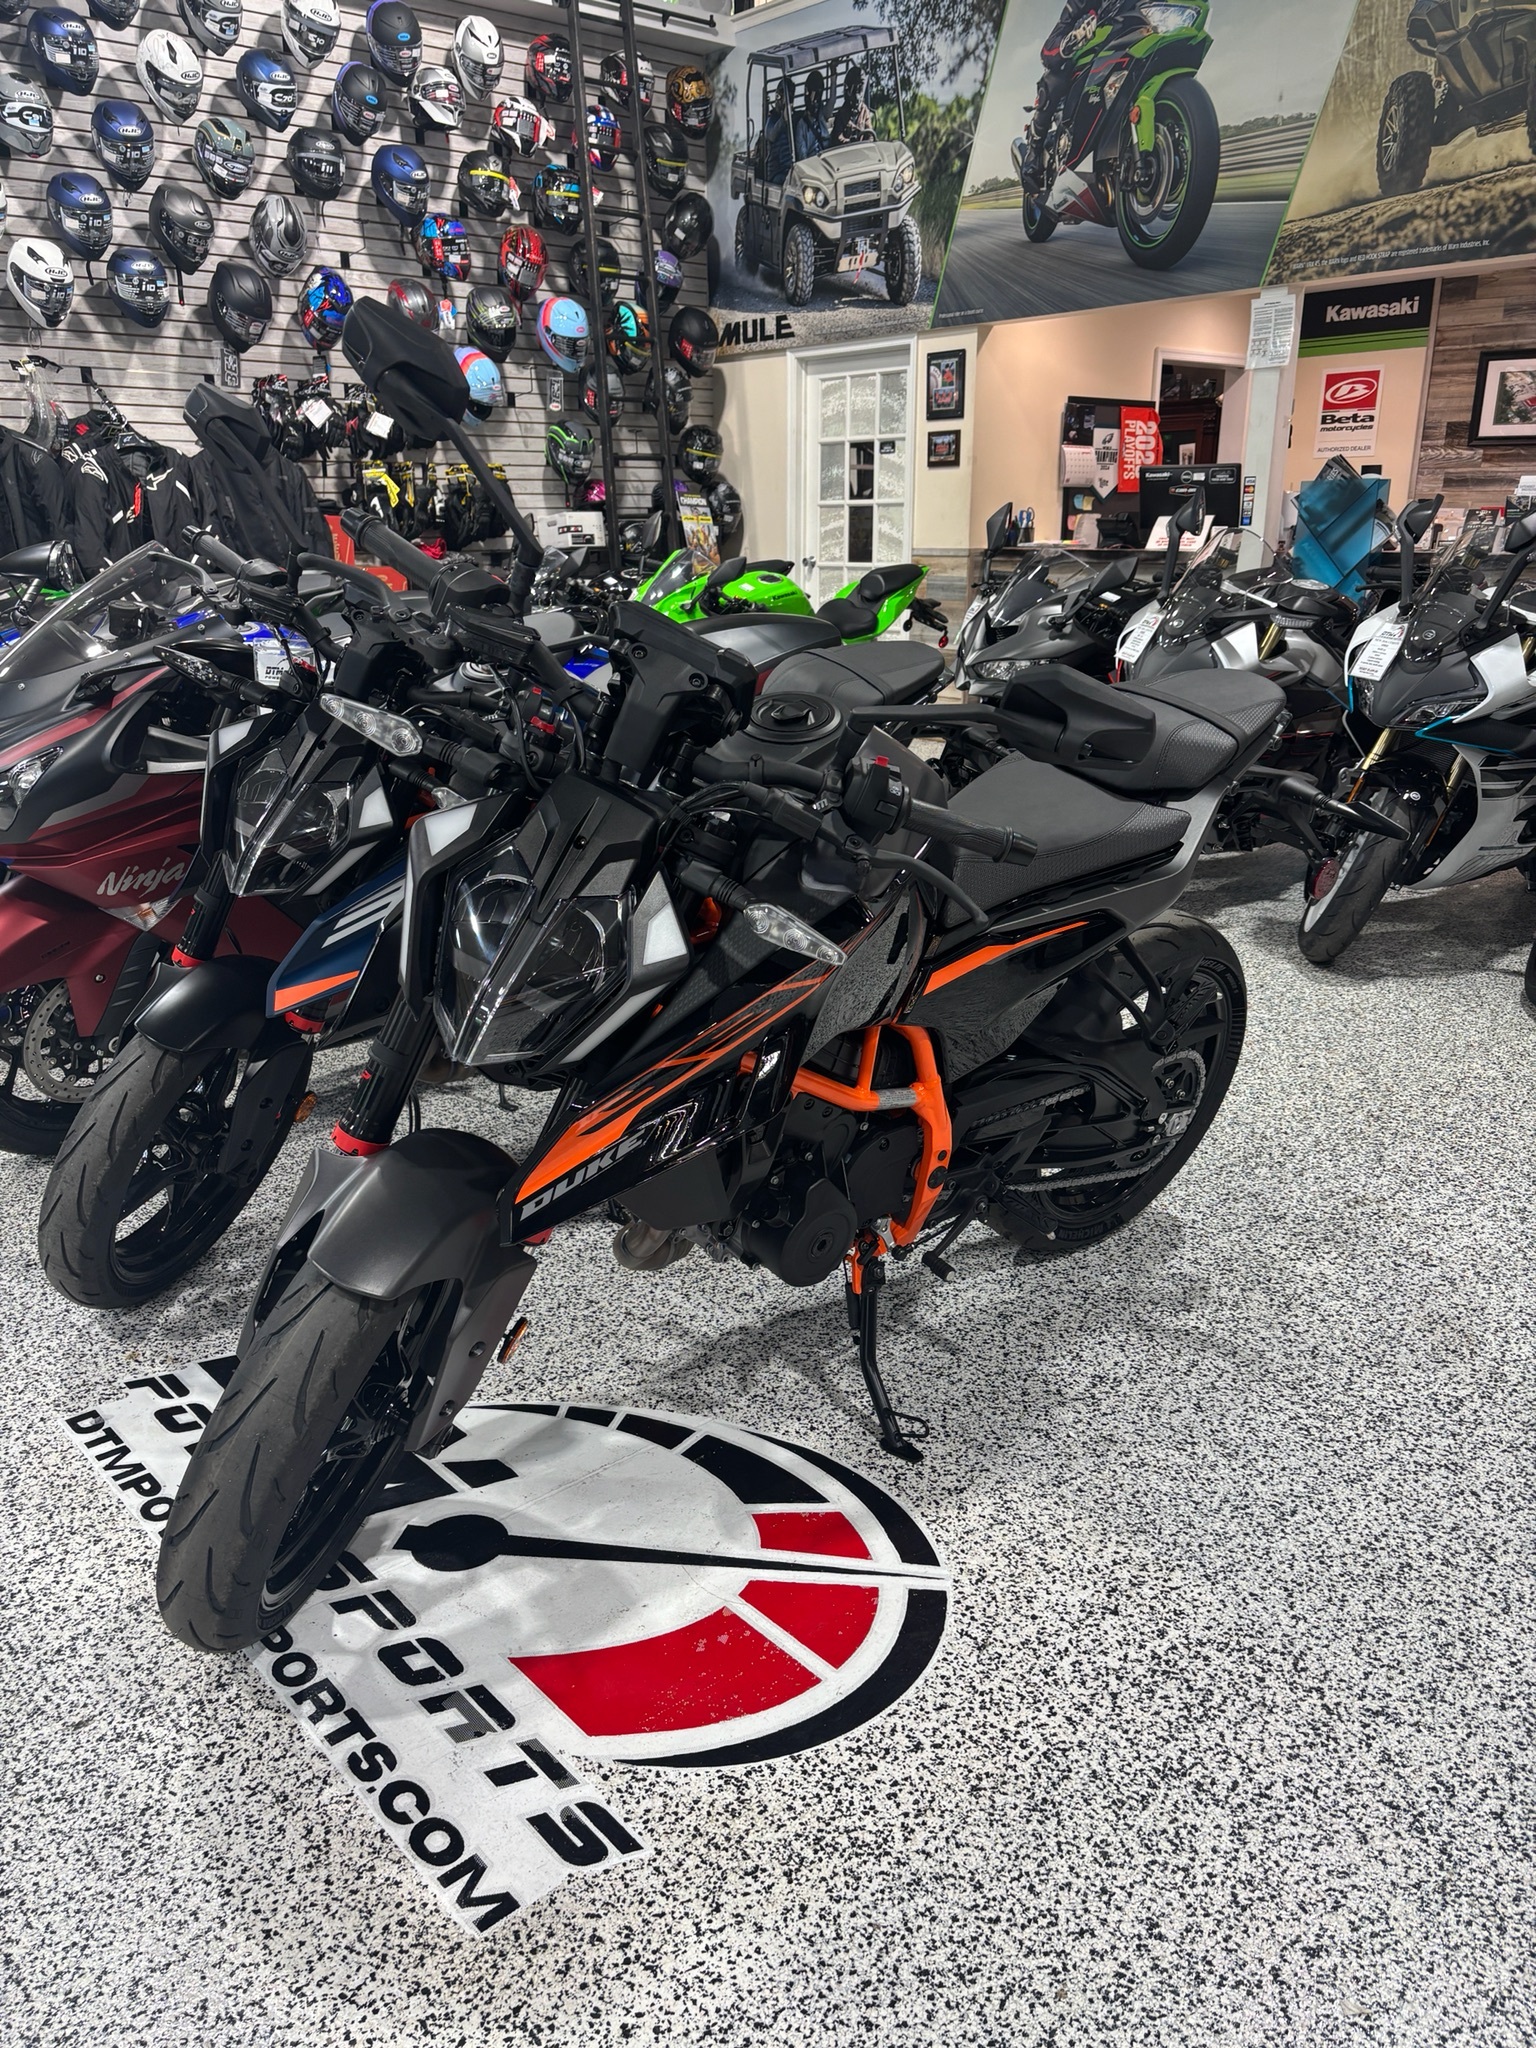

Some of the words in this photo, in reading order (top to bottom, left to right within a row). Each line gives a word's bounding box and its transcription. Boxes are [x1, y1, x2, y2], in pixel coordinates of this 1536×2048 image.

[183, 71, 199, 79] HJC
[1398, 248, 1419, 256] registered
[1419, 245, 1442, 254] trademarks
[1325, 296, 1420, 322] Kawasaki
[718, 315, 795, 346] MULE
[1319, 424, 1374, 432] motorcycles
[1320, 412, 1375, 425] Beta
[1123, 419, 1136, 480] PLAYOFFS
[1135, 420, 1157, 479] 202
[97, 857, 185, 898] Ninja
[520, 1129, 646, 1221] DUKE
